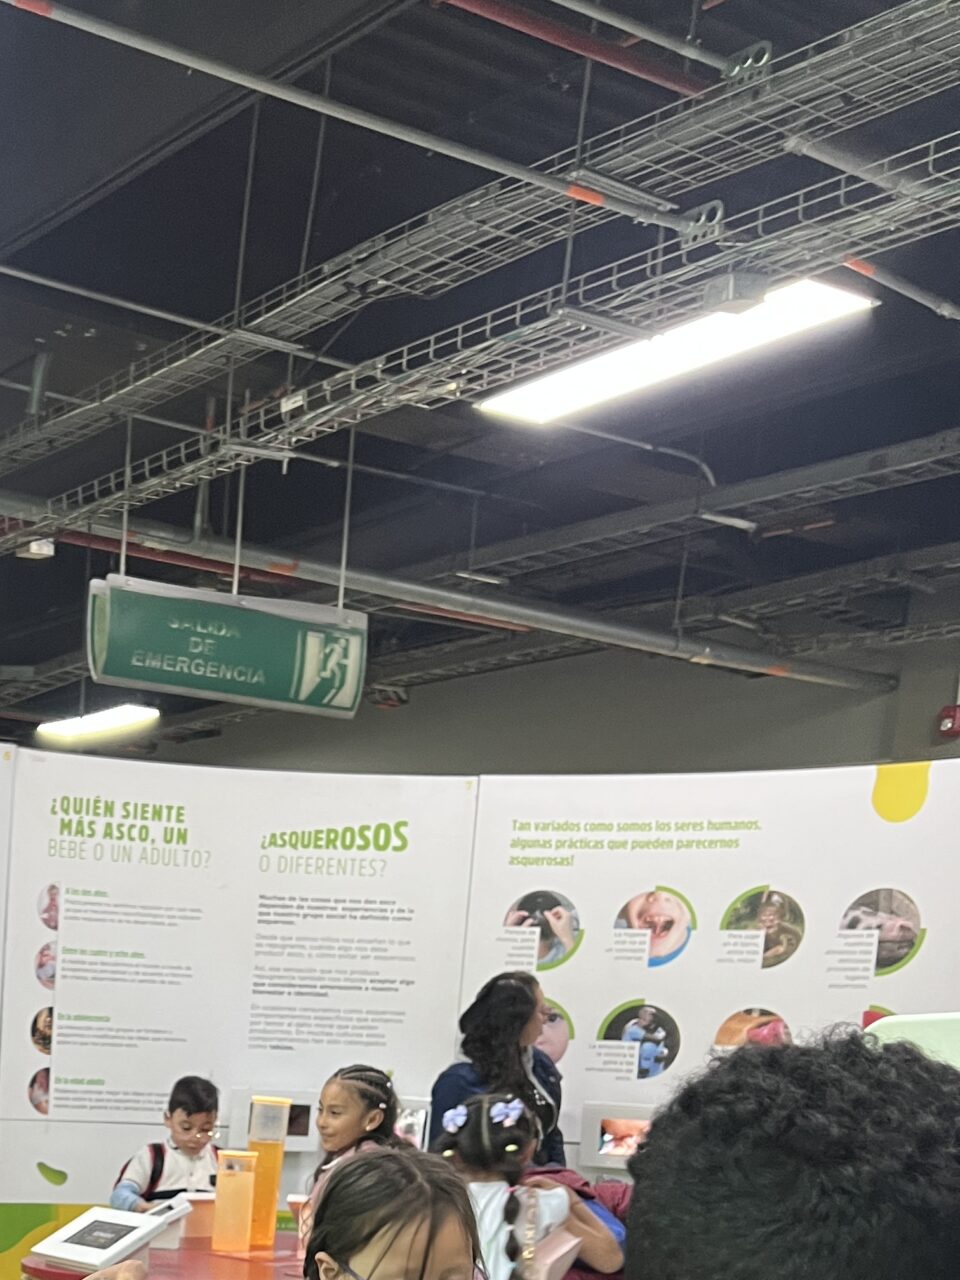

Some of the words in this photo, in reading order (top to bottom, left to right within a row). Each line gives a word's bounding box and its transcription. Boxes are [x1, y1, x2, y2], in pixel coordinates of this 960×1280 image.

[189, 636, 216, 655] DE
[131, 651, 266, 684] EMERGENCIA
[50, 795, 115, 818] ¿QUIÉN
[121, 801, 185, 823] SIENTE
[59, 816, 96, 838] MÁS
[103, 822, 156, 844] ASCO,
[163, 827, 188, 845] UN
[260, 820, 409, 852] ¿ASQUEROSOS
[512, 819, 531, 832] Tan
[534, 819, 581, 832] variados
[583, 822, 615, 833] como
[616, 822, 652, 832] somos
[655, 819, 673, 832] los
[674, 821, 704, 832] seres
[48, 838, 88, 860] BEBÉ
[93, 842, 104, 861] O
[111, 844, 132, 864] UN
[138, 846, 212, 869] ADULTO?
[509, 838, 552, 850] algunas
[554, 837, 604, 851] prácticas
[607, 839, 628, 851] que
[631, 838, 674, 850] pueden
[676, 838, 740, 850] parecernos
[259, 854, 271, 873] O
[277, 855, 387, 877] DIFERENTES?
